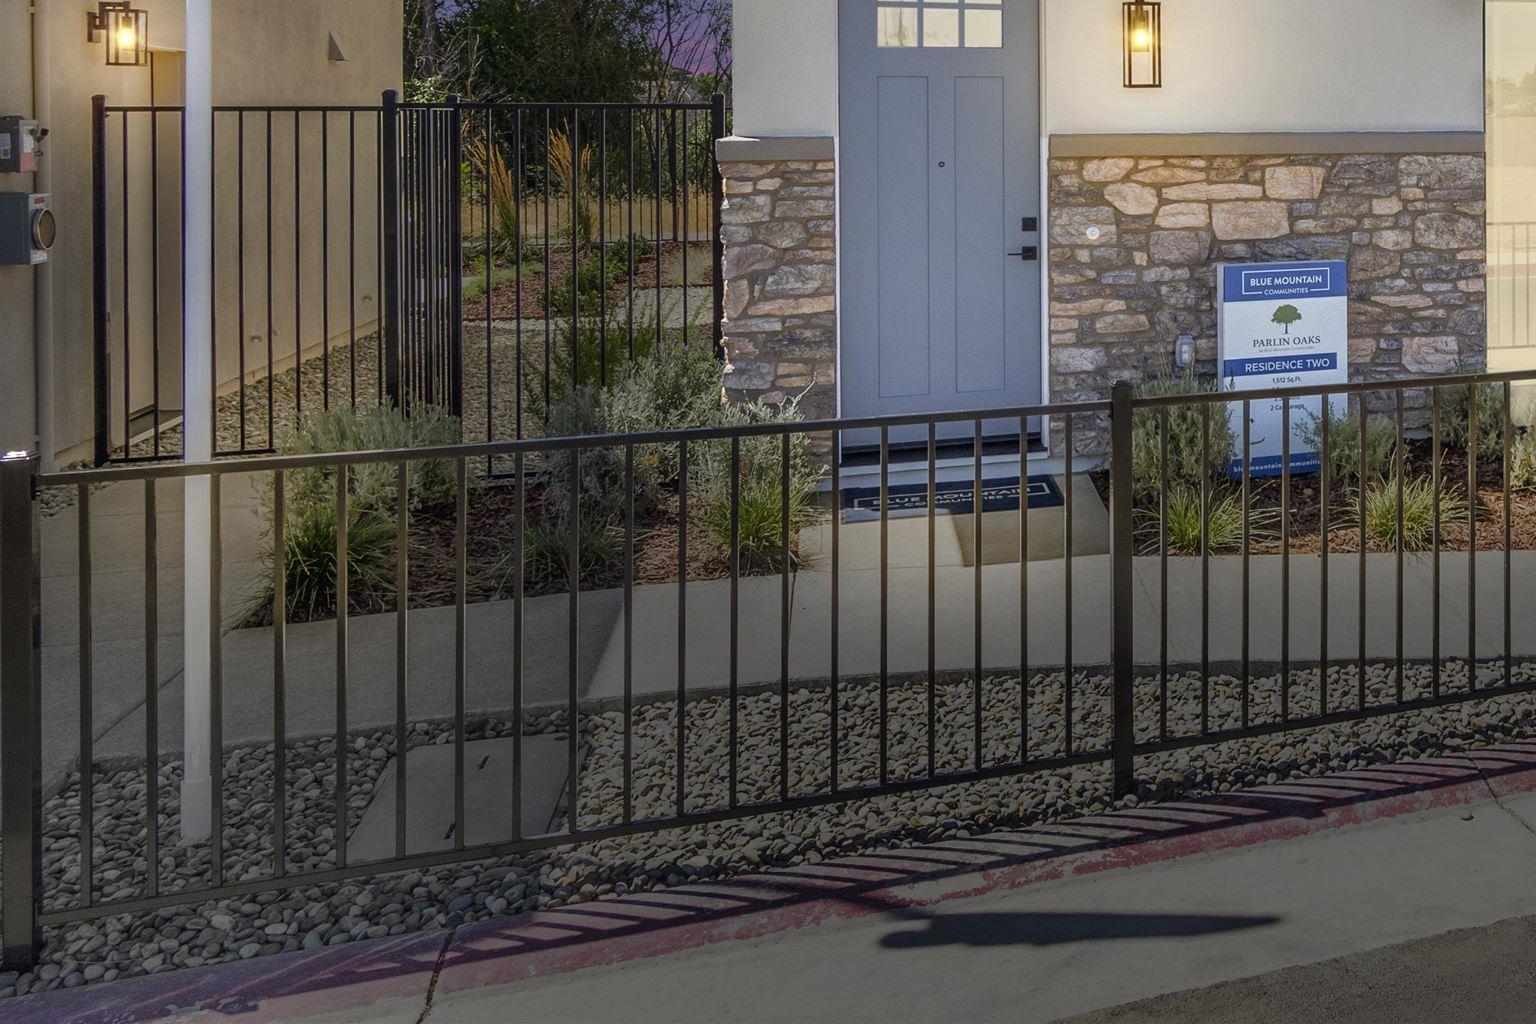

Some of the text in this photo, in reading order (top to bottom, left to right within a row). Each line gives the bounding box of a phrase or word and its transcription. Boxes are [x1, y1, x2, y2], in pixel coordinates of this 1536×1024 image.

[1250, 275, 1322, 286] BLUE MOUNTAIN
[1264, 287, 1309, 296] COMMUNITIES
[1253, 336, 1321, 348] PARLIN OAKS
[1245, 358, 1330, 373] RESIDENCE TWO
